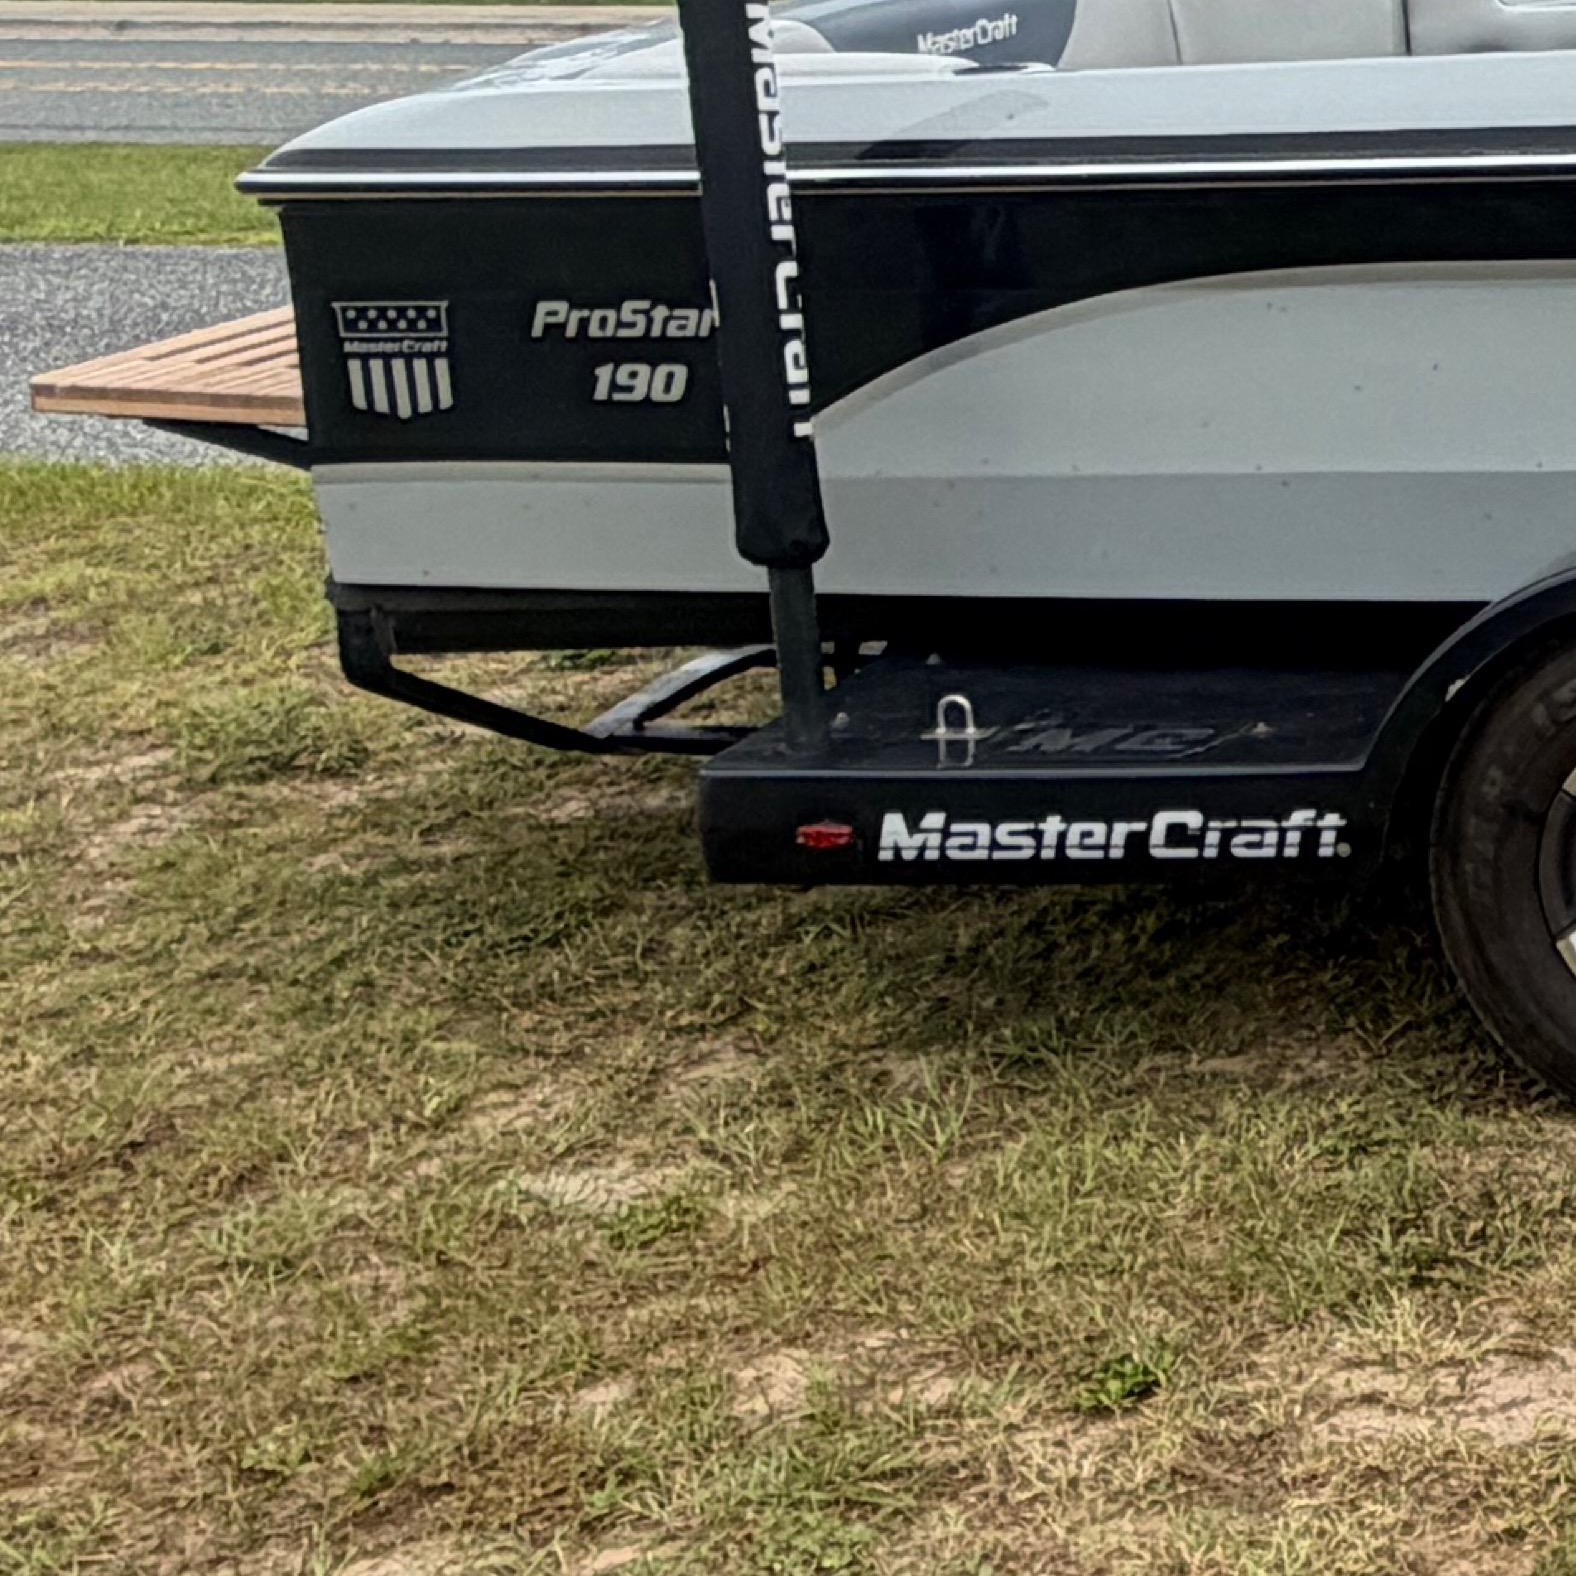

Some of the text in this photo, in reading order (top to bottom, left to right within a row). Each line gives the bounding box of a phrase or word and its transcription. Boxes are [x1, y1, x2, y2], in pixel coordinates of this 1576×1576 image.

[917, 12, 1018, 54] MasterCraft
[531, 300, 716, 339] ProStar
[343, 339, 448, 353] MasterCraft
[592, 362, 689, 403] 190
[877, 809, 1347, 861] MasterCraft
